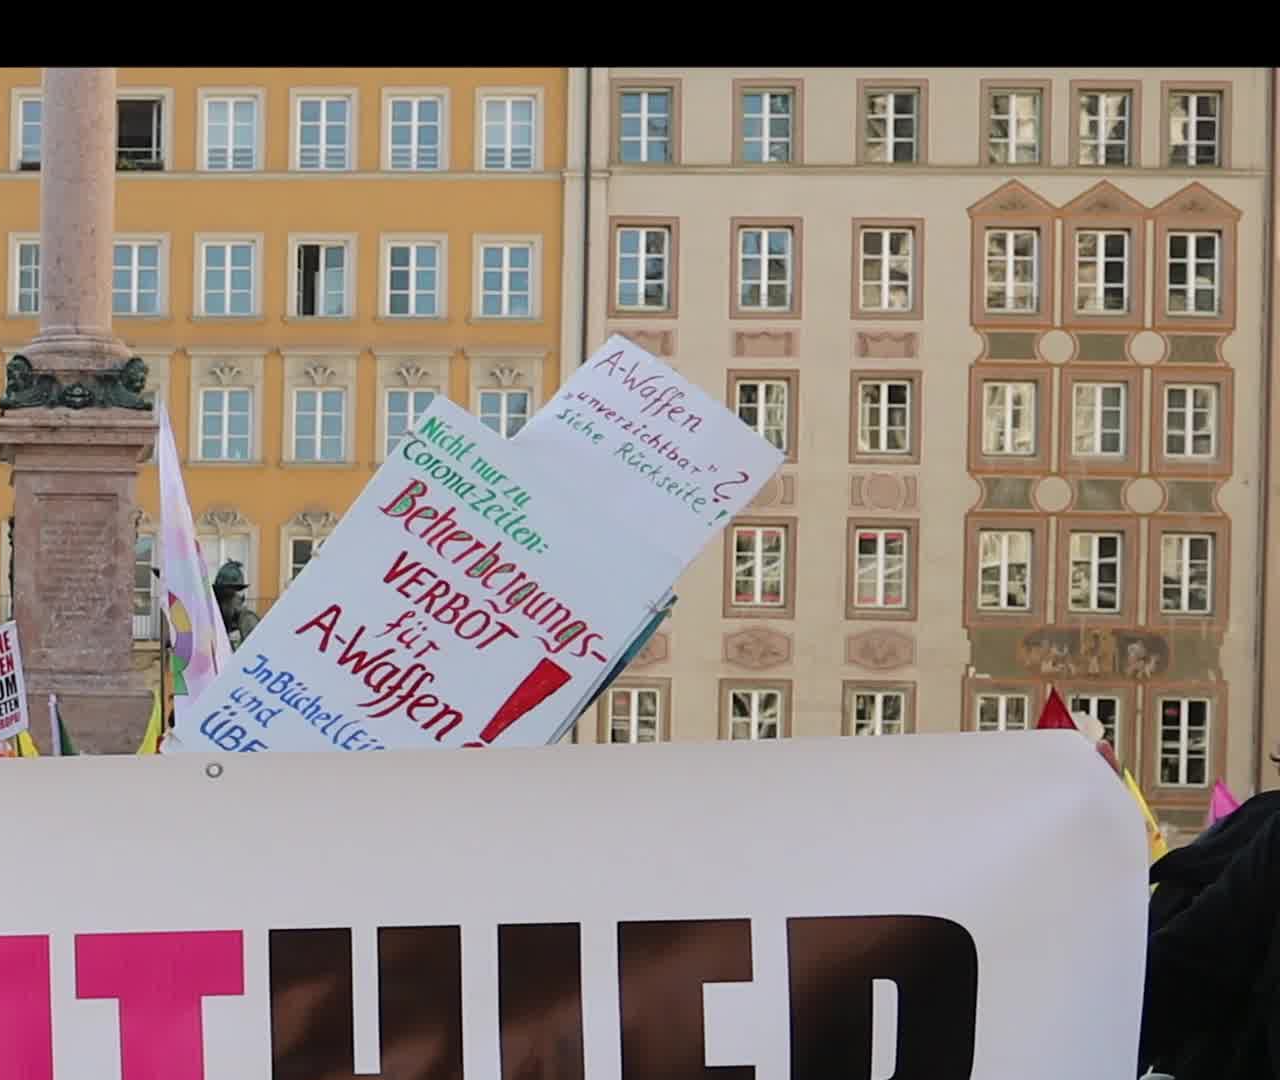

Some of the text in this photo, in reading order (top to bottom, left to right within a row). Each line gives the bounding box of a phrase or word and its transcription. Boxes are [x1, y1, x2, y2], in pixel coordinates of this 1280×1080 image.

[593, 350, 702, 433] A-Waffen
[419, 415, 477, 463] Nicht
[470, 456, 509, 487] nur
[376, 610, 440, 659] für
[383, 551, 519, 649] VERBOT
[230, 686, 283, 729] und
[295, 603, 464, 742] A-Waffen
